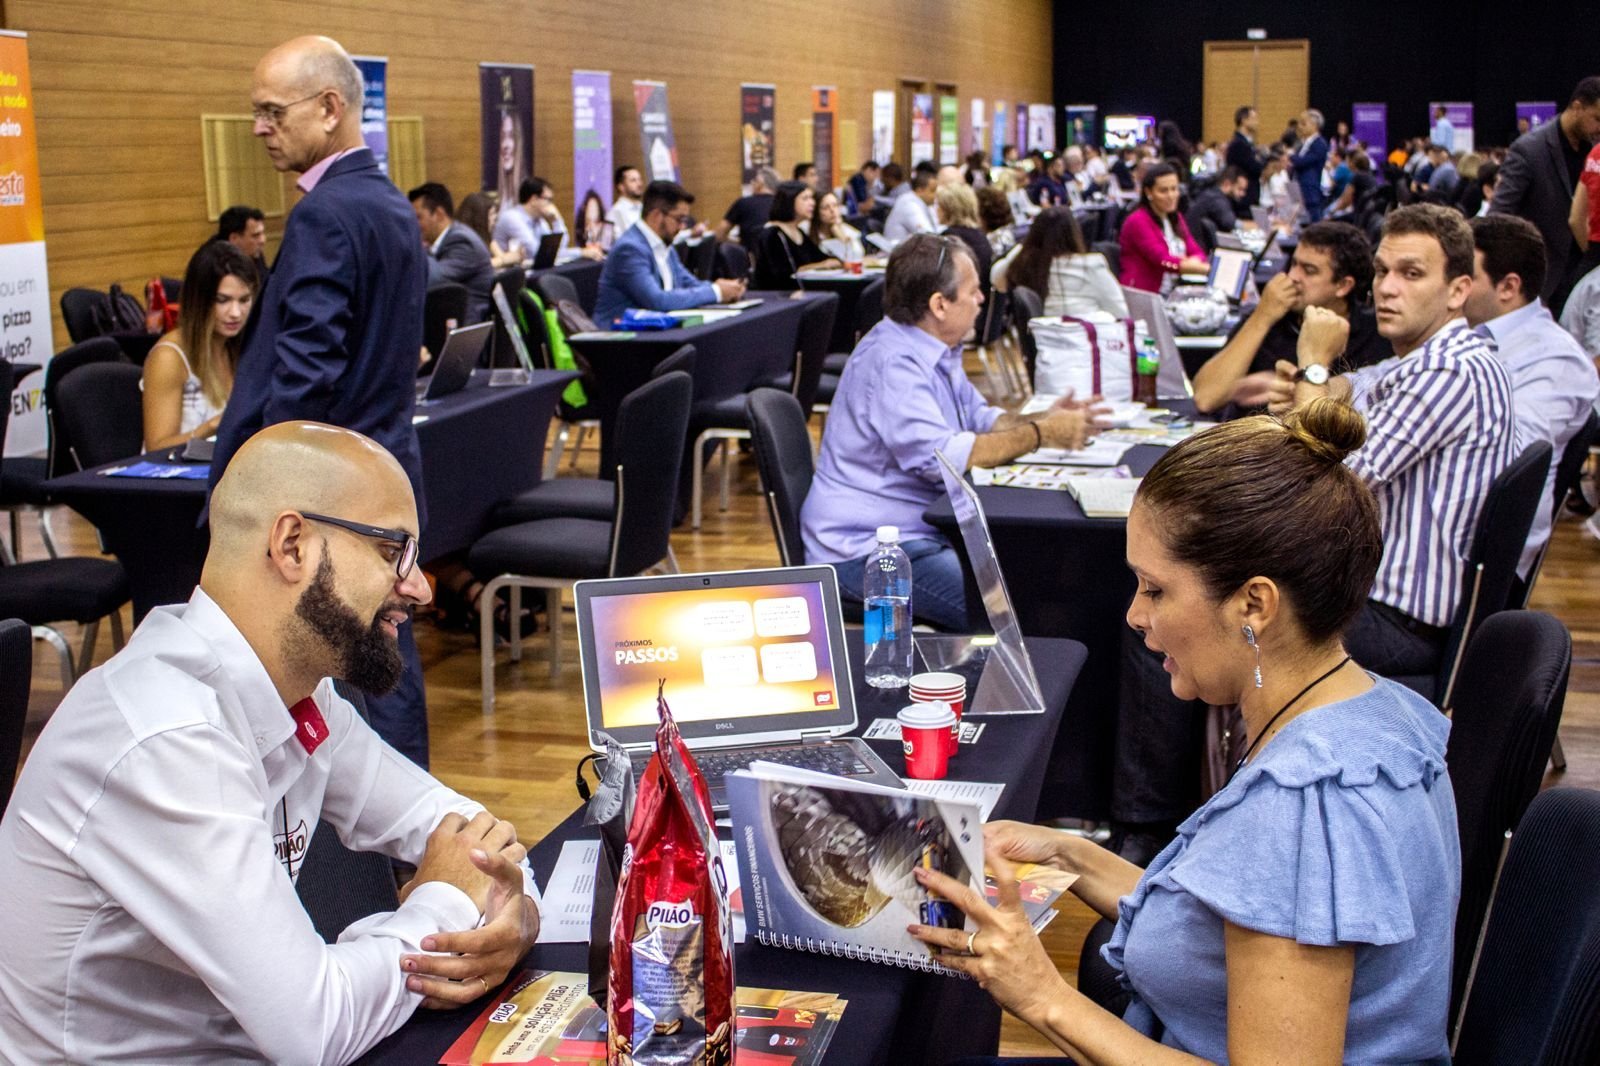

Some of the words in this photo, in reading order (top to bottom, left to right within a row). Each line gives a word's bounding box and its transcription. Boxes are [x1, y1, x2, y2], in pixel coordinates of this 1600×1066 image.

[3, 307, 32, 333] pizza
[0, 336, 32, 361] ulpa?
[615, 639, 653, 648] PRÓXIMOS
[615, 645, 679, 666] PASSOS
[752, 874, 763, 909] SERVIÇOS
[648, 905, 691, 924] PILÃO
[757, 910, 766, 927] BMW
[492, 1004, 515, 1021] PILÃO
[502, 1042, 522, 1055] Tenha
[517, 1030, 531, 1041] uma
[524, 1003, 554, 1029] solução
[545, 985, 569, 1002] Pilão
